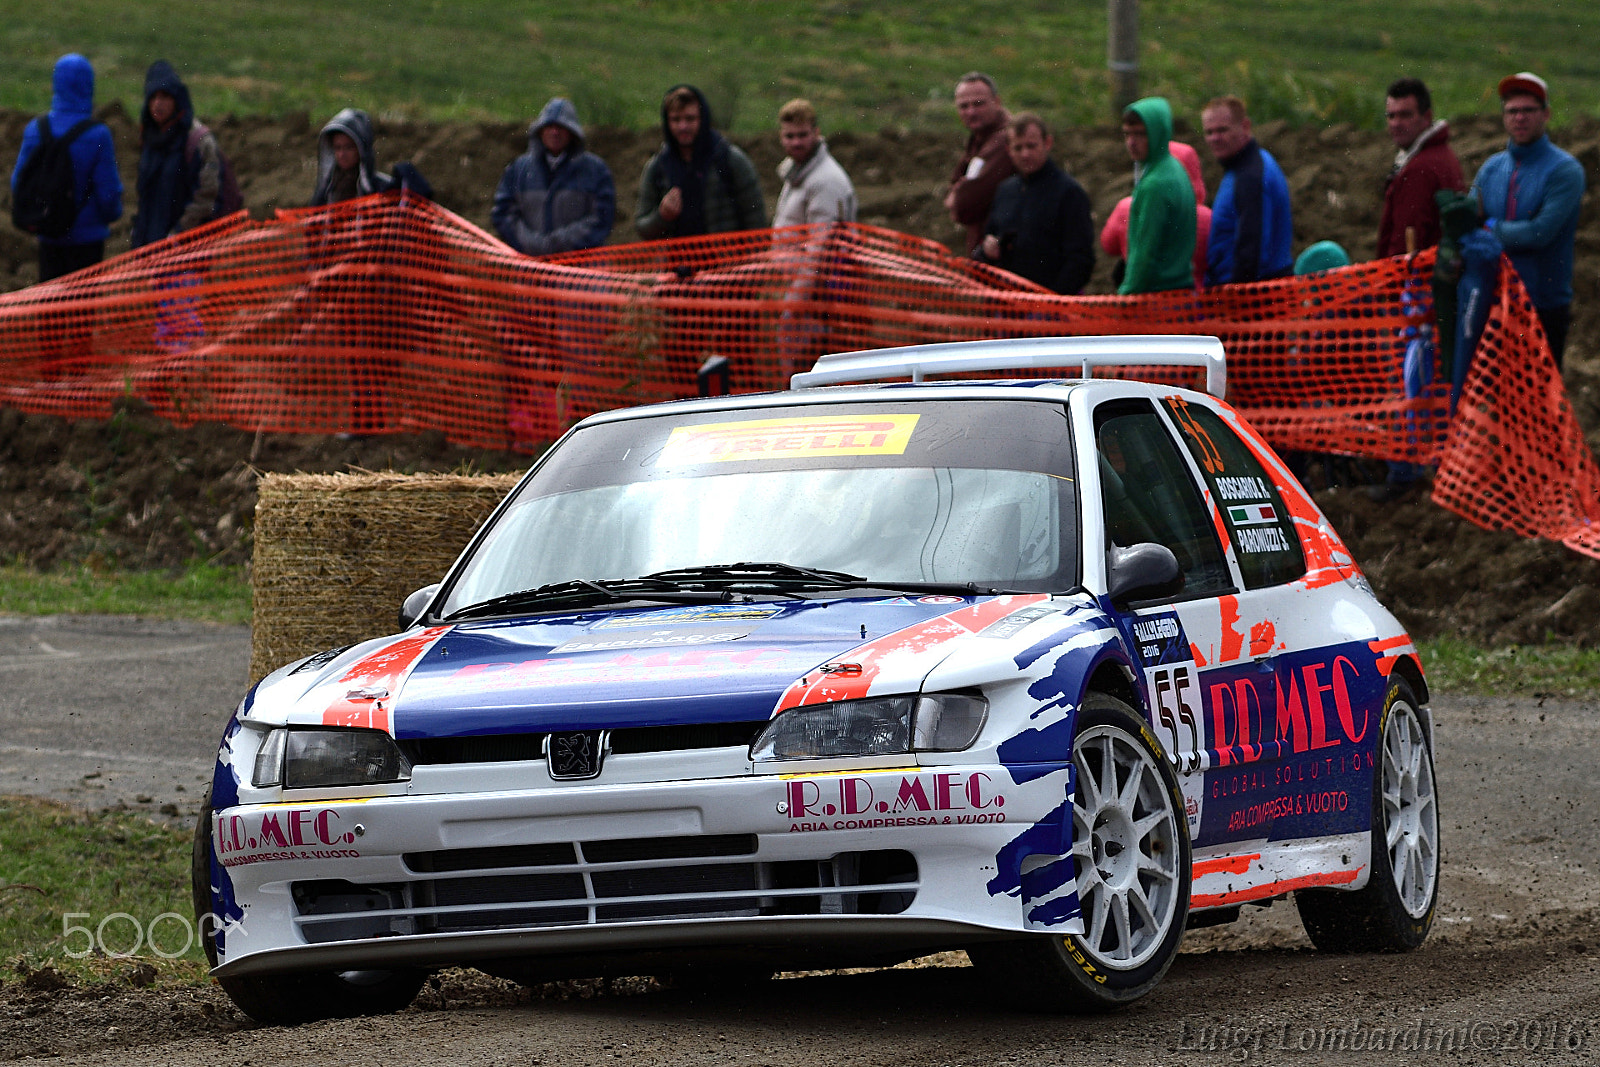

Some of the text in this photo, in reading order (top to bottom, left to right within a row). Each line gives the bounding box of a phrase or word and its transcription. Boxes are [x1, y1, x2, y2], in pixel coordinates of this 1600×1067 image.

[1165, 395, 1224, 474] 55
[1142, 644, 1160, 658] 2016
[1154, 667, 1201, 774] 55
[1274, 655, 1369, 757] MEC
[1212, 771, 1266, 799] GLOBAL
[1275, 751, 1374, 785] SOLUTION
[790, 812, 1006, 833] ARIA COMPRESSA & VUOTO
[1247, 796, 1294, 828] COMPRESSA
[1296, 794, 1303, 814] &
[1306, 791, 1348, 814] VUOTO
[234, 851, 299, 866] COMPRESSA
[301, 851, 310, 859] &
[311, 849, 360, 859] VUOTO
